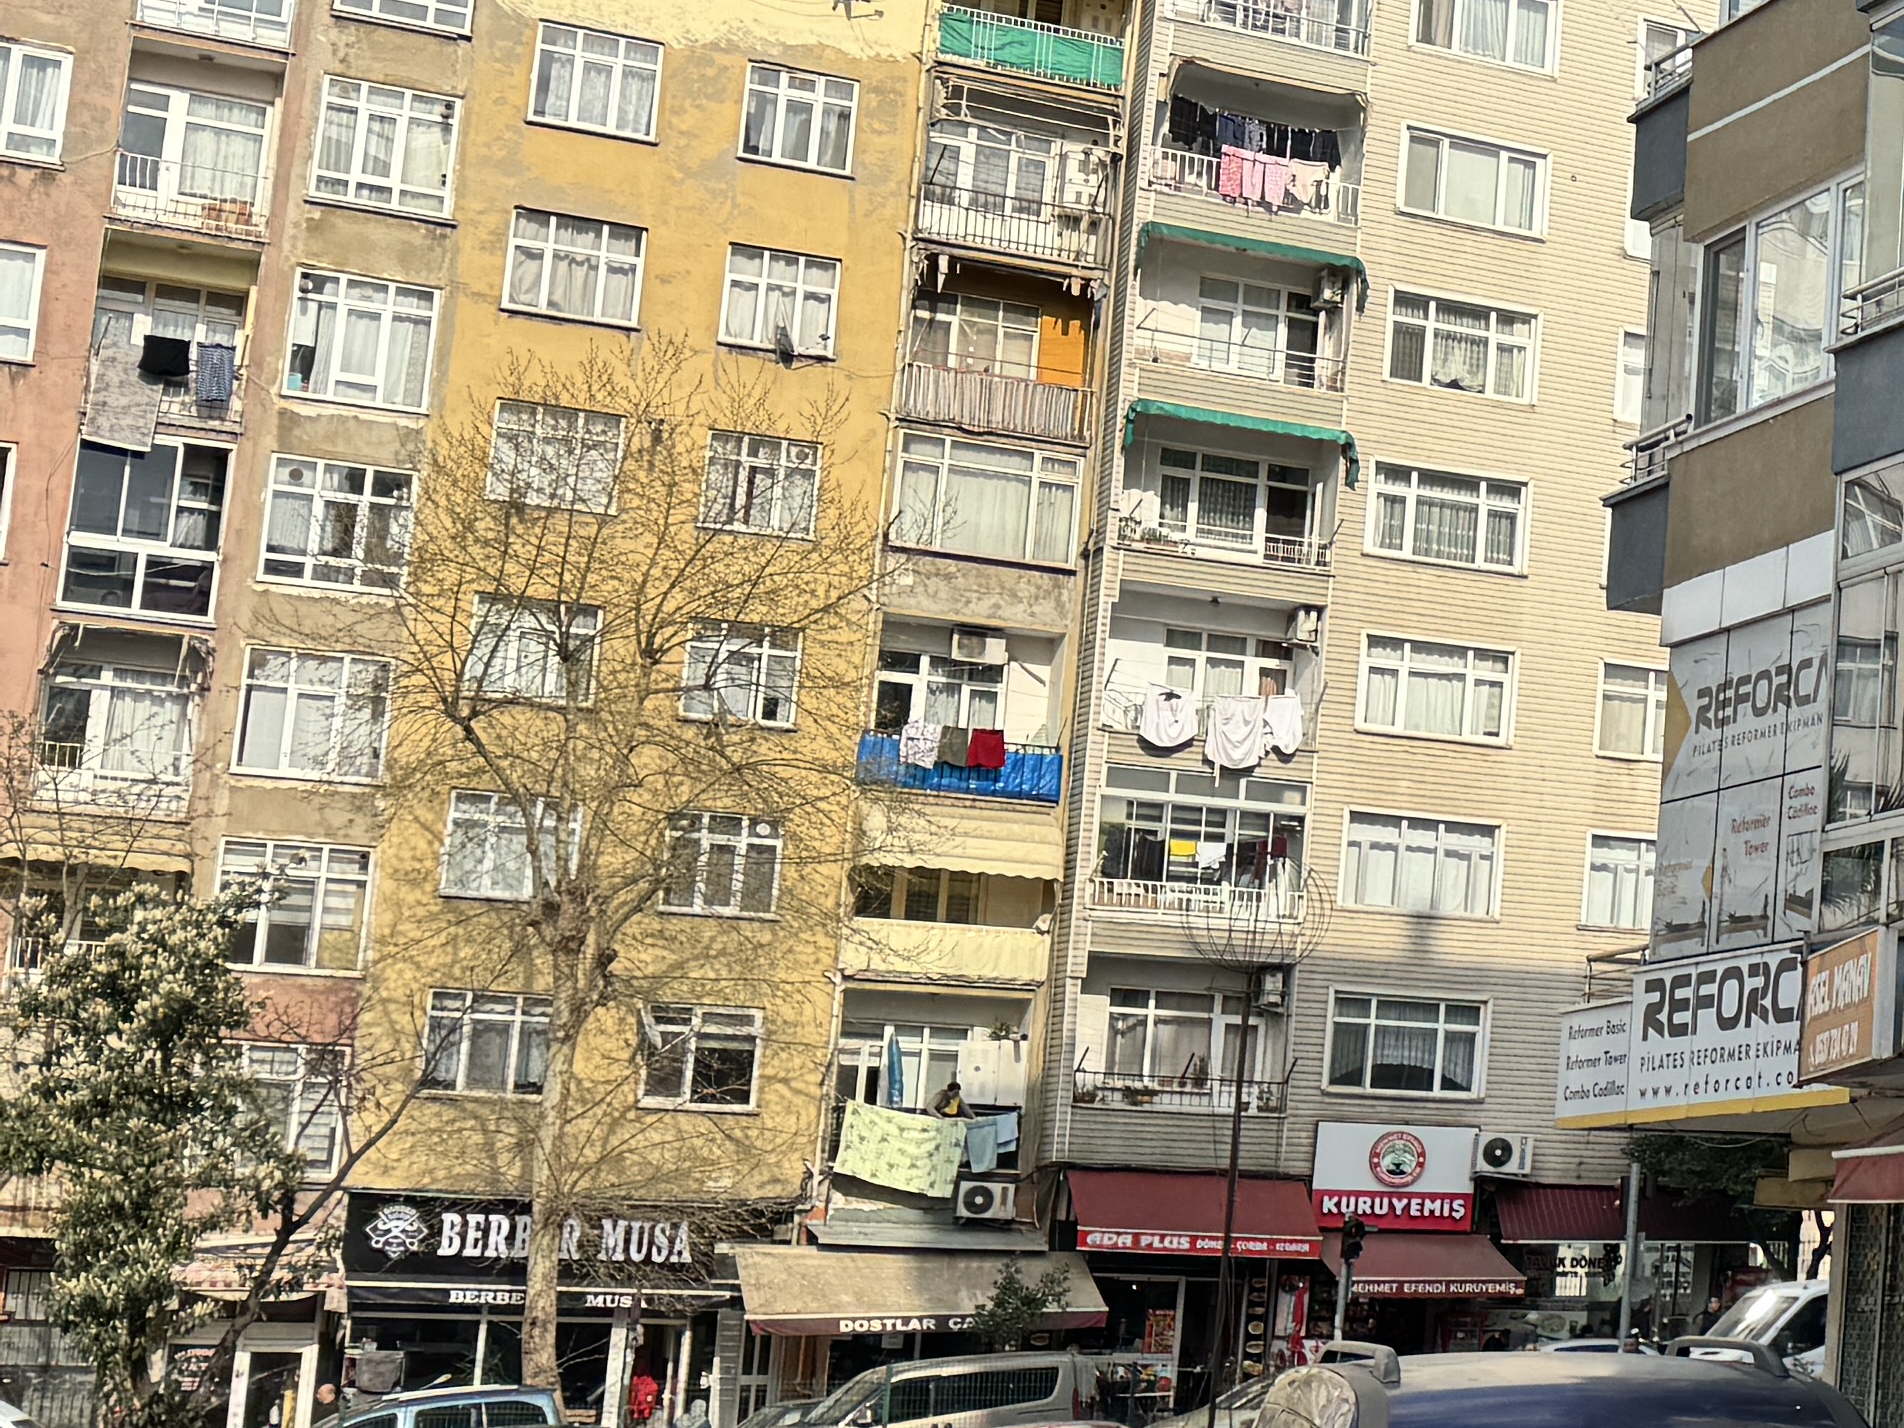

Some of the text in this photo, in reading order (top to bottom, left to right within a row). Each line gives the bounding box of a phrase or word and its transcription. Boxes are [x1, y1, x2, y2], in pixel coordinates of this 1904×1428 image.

[1569, 1018, 1626, 1040] Reformer Basic
[1566, 1051, 1627, 1071] Reformer Tower
[1640, 1051, 1685, 1073] PİLATES
[1689, 1043, 1751, 1066] REFORMER
[1321, 1195, 1466, 1220] KURUYEMİŞ
[437, 1211, 693, 1264] BERBR MUSA
[1141, 1234, 1191, 1250] PLUS
[1403, 1281, 1447, 1293] EFENDİ
[839, 1318, 936, 1333] DOSTLAR
